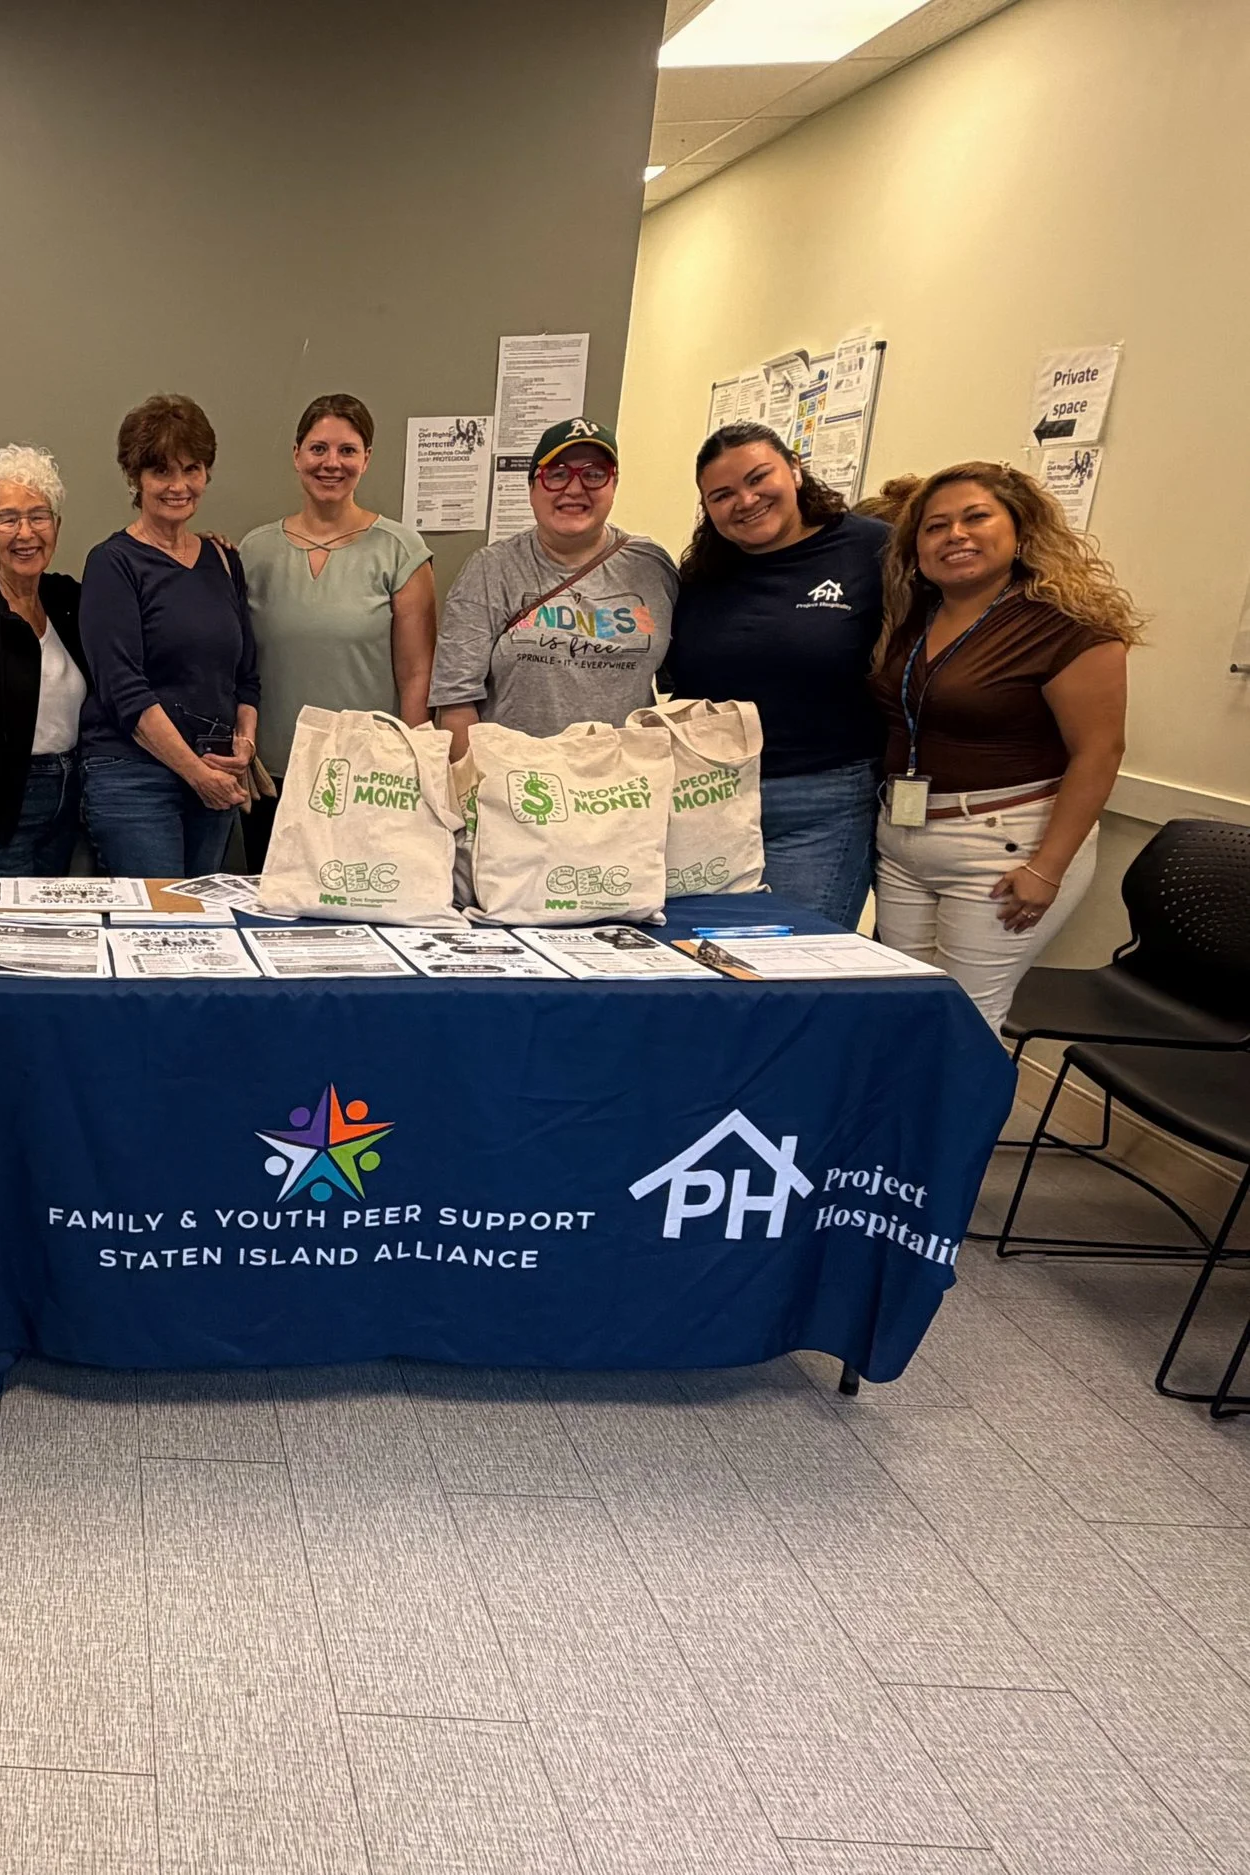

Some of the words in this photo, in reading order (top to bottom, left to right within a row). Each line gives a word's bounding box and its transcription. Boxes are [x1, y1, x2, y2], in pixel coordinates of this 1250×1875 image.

[1053, 366, 1099, 387] Private
[1052, 399, 1088, 418] space
[565, 419, 599, 439] A's
[539, 633, 567, 648] is
[570, 636, 623, 659] free
[516, 653, 555, 665] SPRINKLE
[563, 659, 572, 667] IT
[580, 660, 638, 670] EVERYWHERE
[353, 774, 369, 783] the
[369, 771, 420, 792] PEOPLE'S
[579, 776, 649, 800] PEOPLE'S
[680, 768, 740, 791] PEOPLES
[353, 785, 421, 811] MONEY
[574, 791, 652, 815] MONEY
[672, 778, 742, 813] MONEY
[319, 859, 400, 893] CEC
[546, 864, 633, 896] CEC
[318, 892, 348, 906] NYC
[545, 899, 578, 910] NYC
[822, 1165, 928, 1209] Project
[663, 1168, 791, 1239] PH
[49, 1207, 164, 1233] FAMILY
[180, 1210, 198, 1229] &
[215, 1209, 326, 1230] YOUTH
[343, 1204, 422, 1229] PEER
[439, 1207, 596, 1231] SUPPORT
[814, 1203, 959, 1266] Hospitalit
[100, 1247, 222, 1270] STATEN
[239, 1247, 359, 1265] ISLAND
[374, 1241, 539, 1269] ALLIANCE
